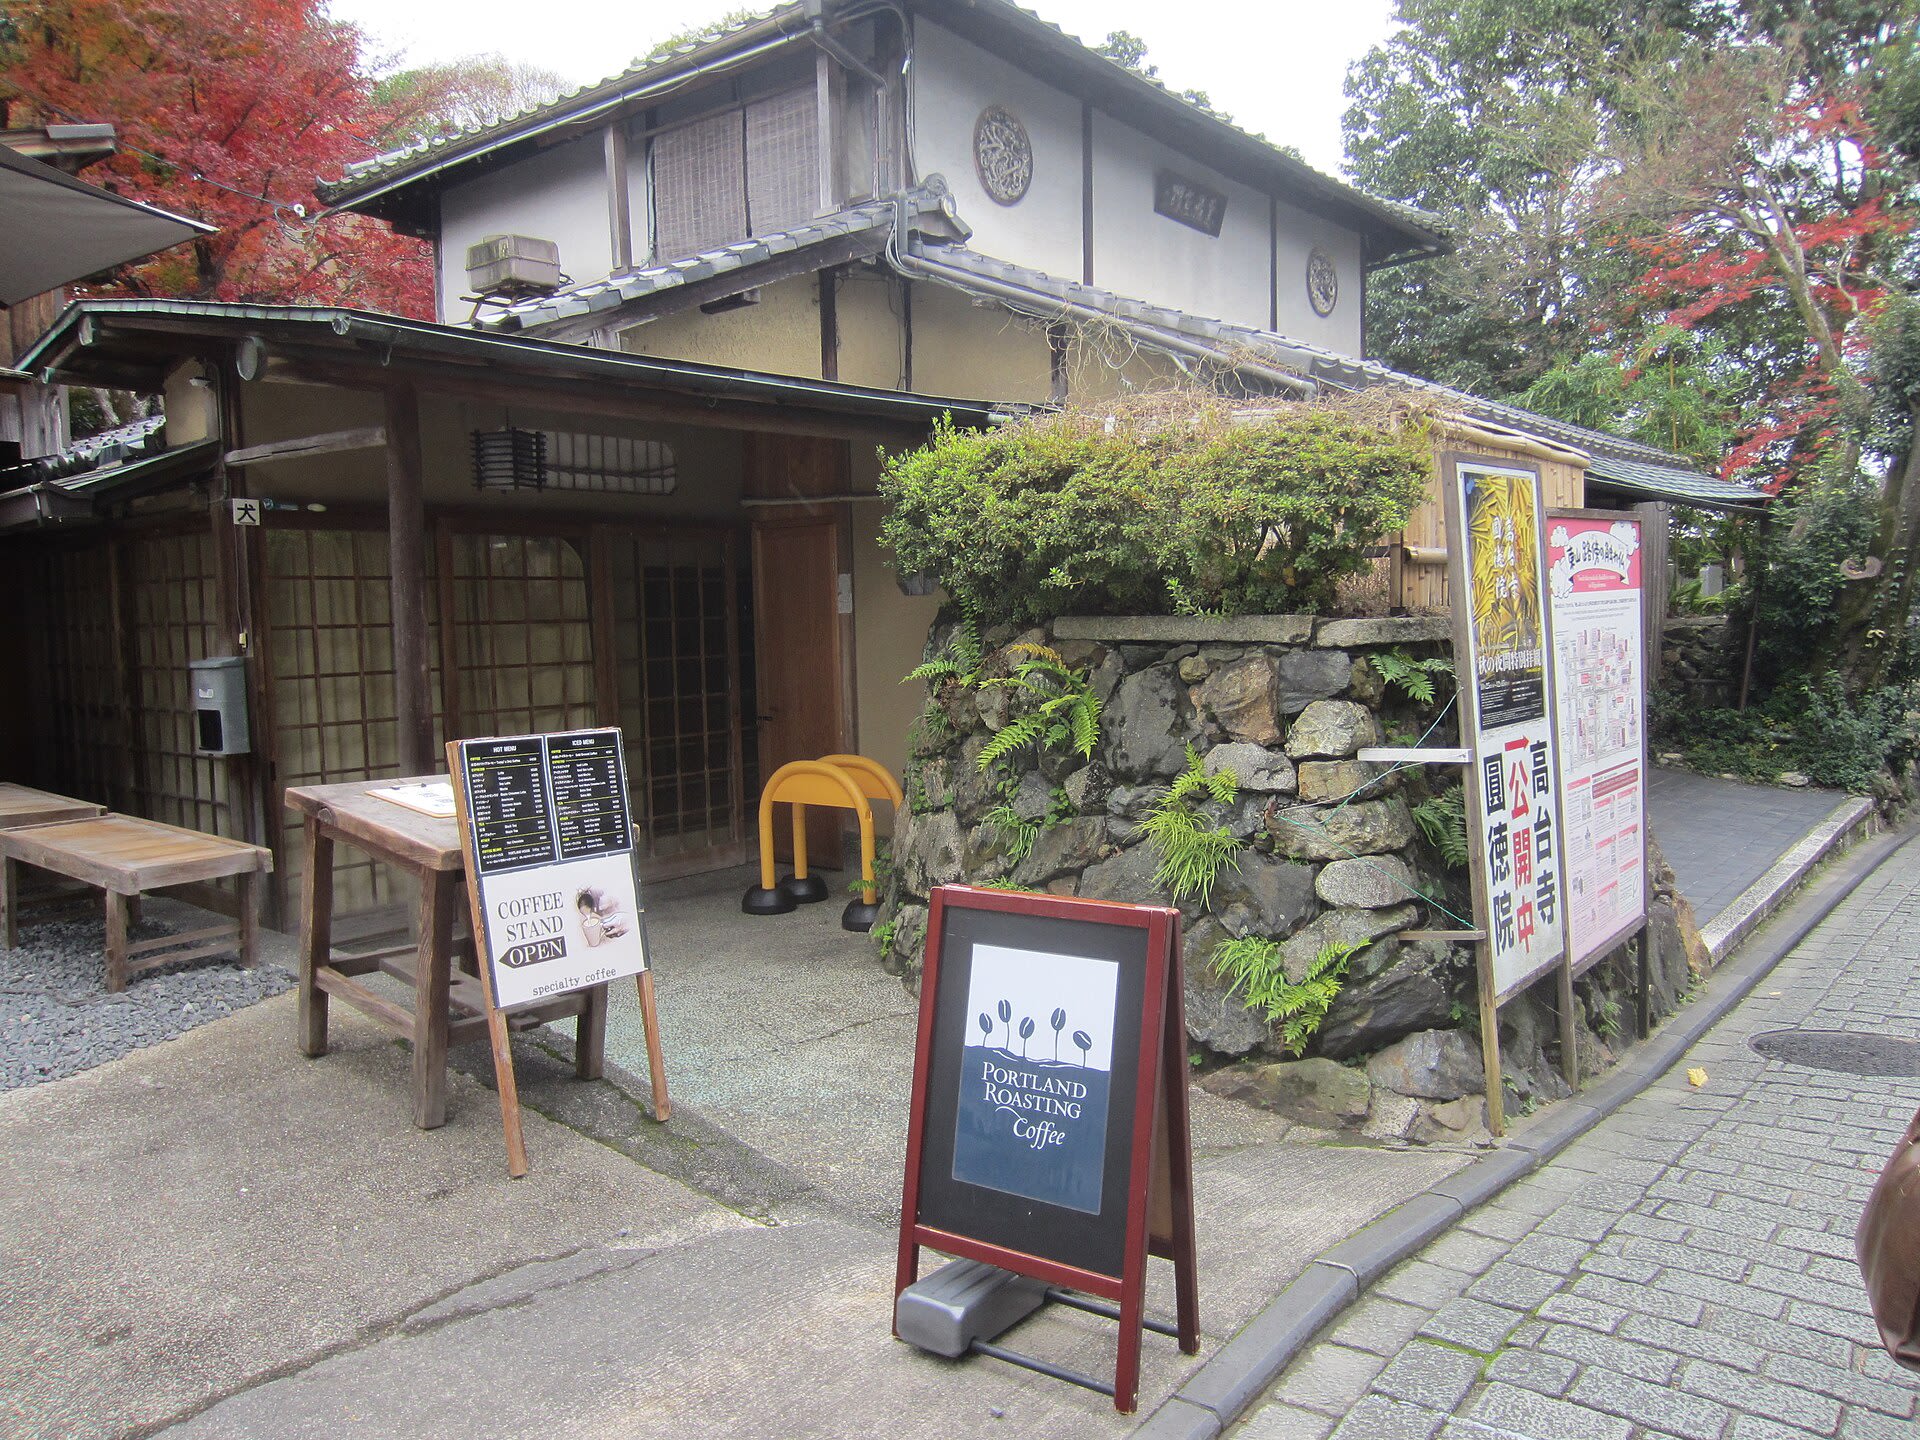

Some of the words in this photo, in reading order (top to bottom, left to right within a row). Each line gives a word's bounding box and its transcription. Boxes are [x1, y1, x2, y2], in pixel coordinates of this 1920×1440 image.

[237, 503, 256, 522] 犬
[1530, 740, 1555, 925] 高台寺
[1483, 752, 1514, 957] 圓徳院
[1509, 760, 1535, 954] 公開中
[498, 891, 563, 920] COFFEE
[506, 915, 563, 942] STAND
[509, 939, 563, 966] OPEN
[533, 976, 580, 996] specialty
[585, 967, 617, 983] coffee
[981, 1061, 1087, 1099] PORTLAND
[983, 1081, 1082, 1119] ROASTING
[1008, 1112, 1065, 1150] Coffee
